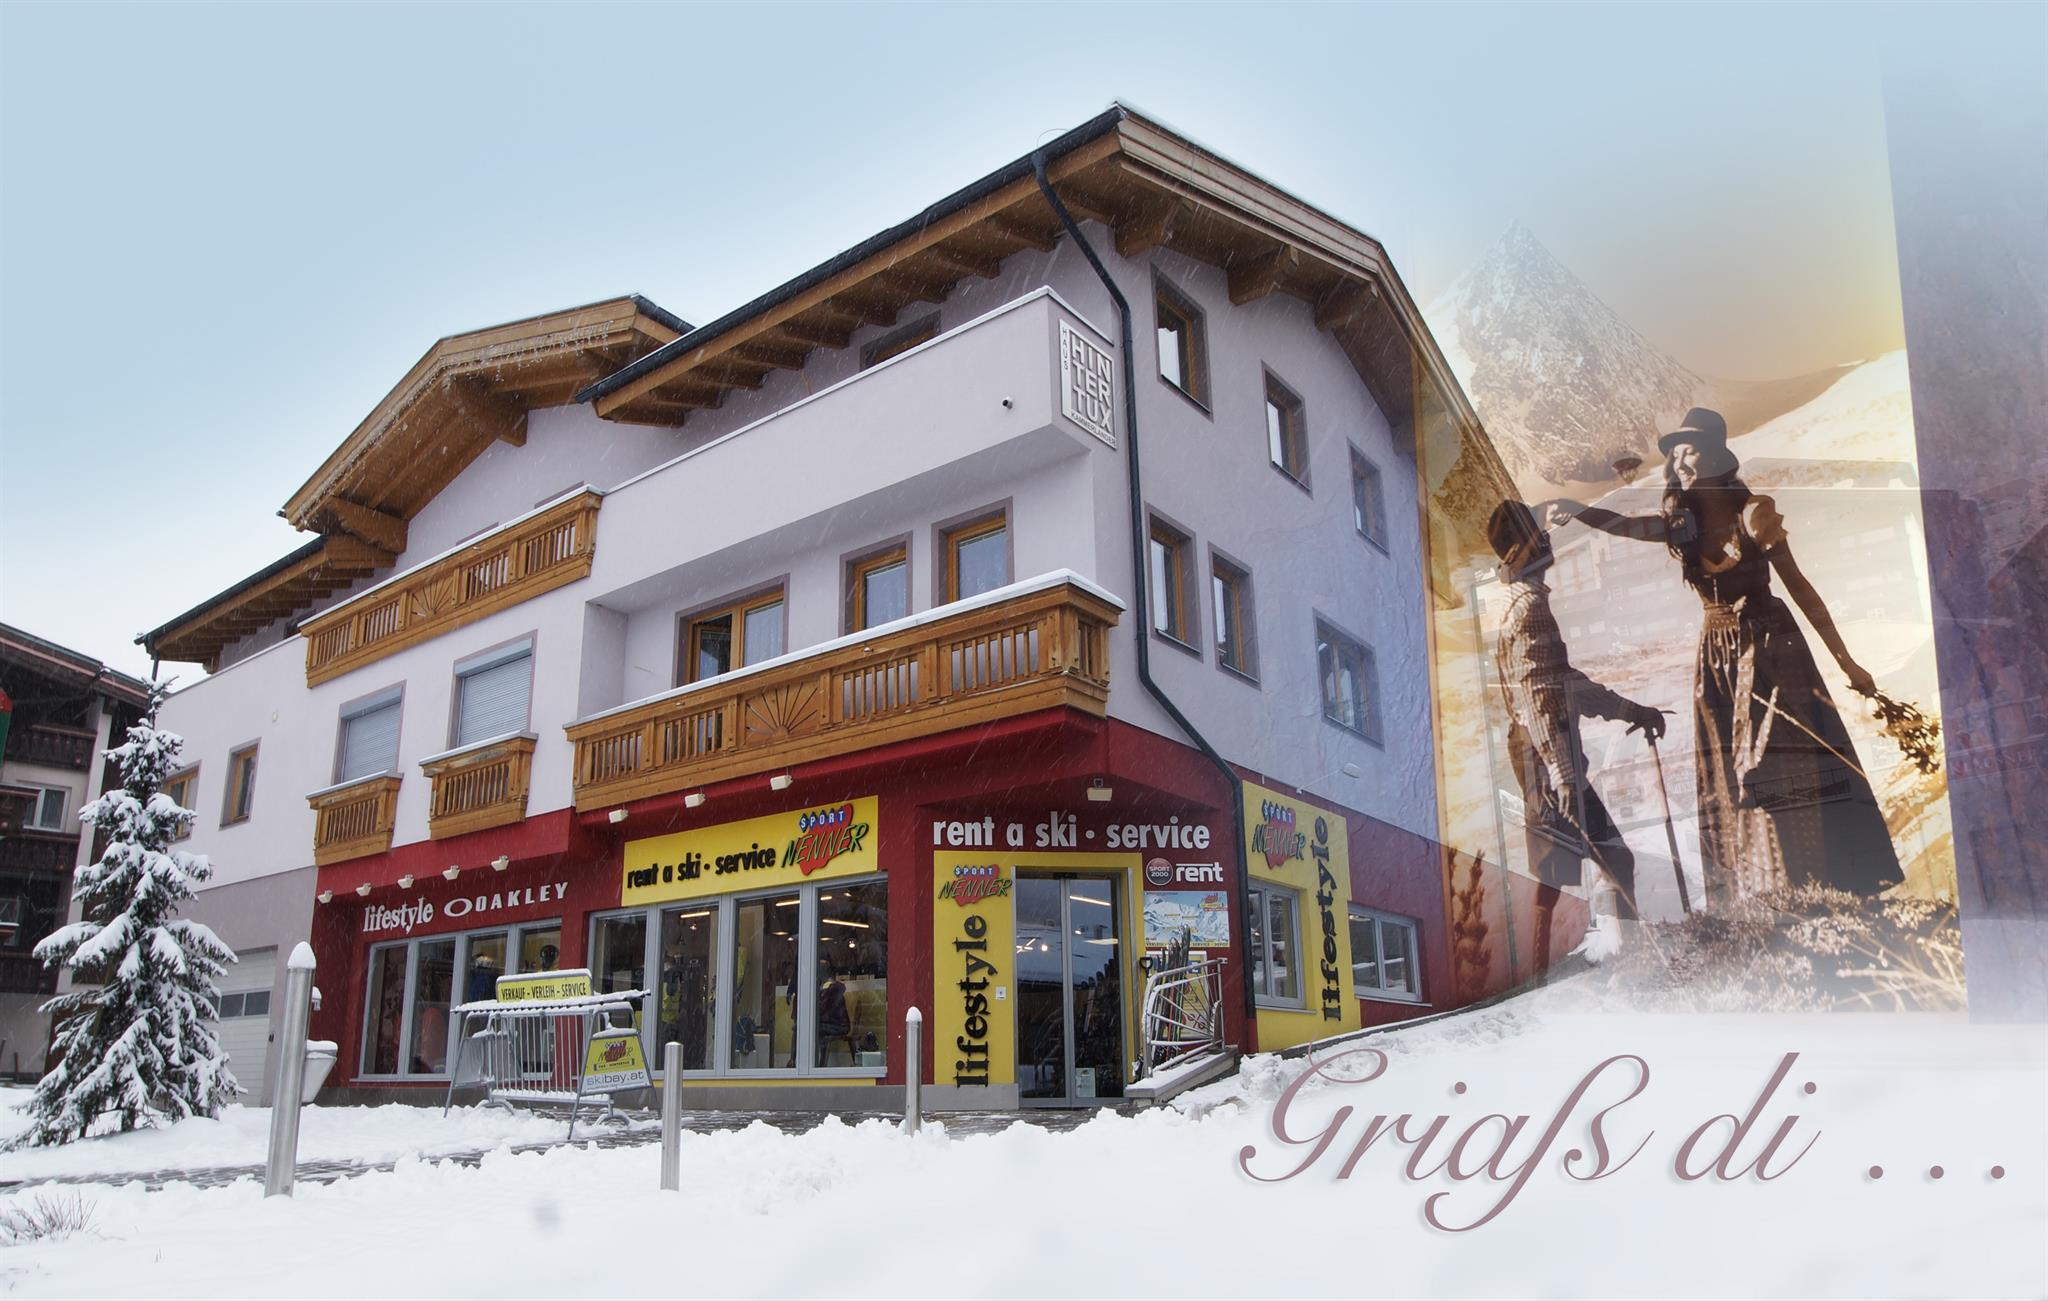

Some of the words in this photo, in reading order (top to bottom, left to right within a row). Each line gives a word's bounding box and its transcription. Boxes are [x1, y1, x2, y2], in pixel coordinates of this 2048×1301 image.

[1071, 333, 1111, 383] HIN
[1072, 359, 1111, 408] TER
[1073, 385, 1112, 433] TUX
[800, 810, 845, 830] SPORT
[933, 816, 995, 846] rent
[1006, 823, 1024, 847] a
[1035, 811, 1077, 848] ski
[1106, 816, 1211, 849] service
[1263, 806, 1293, 824] SPORT
[781, 822, 869, 868] NENNER
[1252, 823, 1307, 861] NENNER
[627, 862, 658, 889] rent
[663, 864, 673, 883] a
[677, 852, 701, 881] ski
[715, 842, 776, 875] service
[954, 866, 995, 877] SPORT
[1175, 861, 1224, 882] rent
[938, 878, 1012, 900] NENNER
[362, 895, 434, 935] lifestyle
[1311, 815, 1341, 1022] lifestyle
[501, 987, 526, 1001] VERKAUF
[531, 985, 556, 999] VERLEIH
[561, 982, 587, 997] SERVICE
[953, 914, 998, 1089] lifestyle
[587, 1071, 645, 1086] skibay.at
